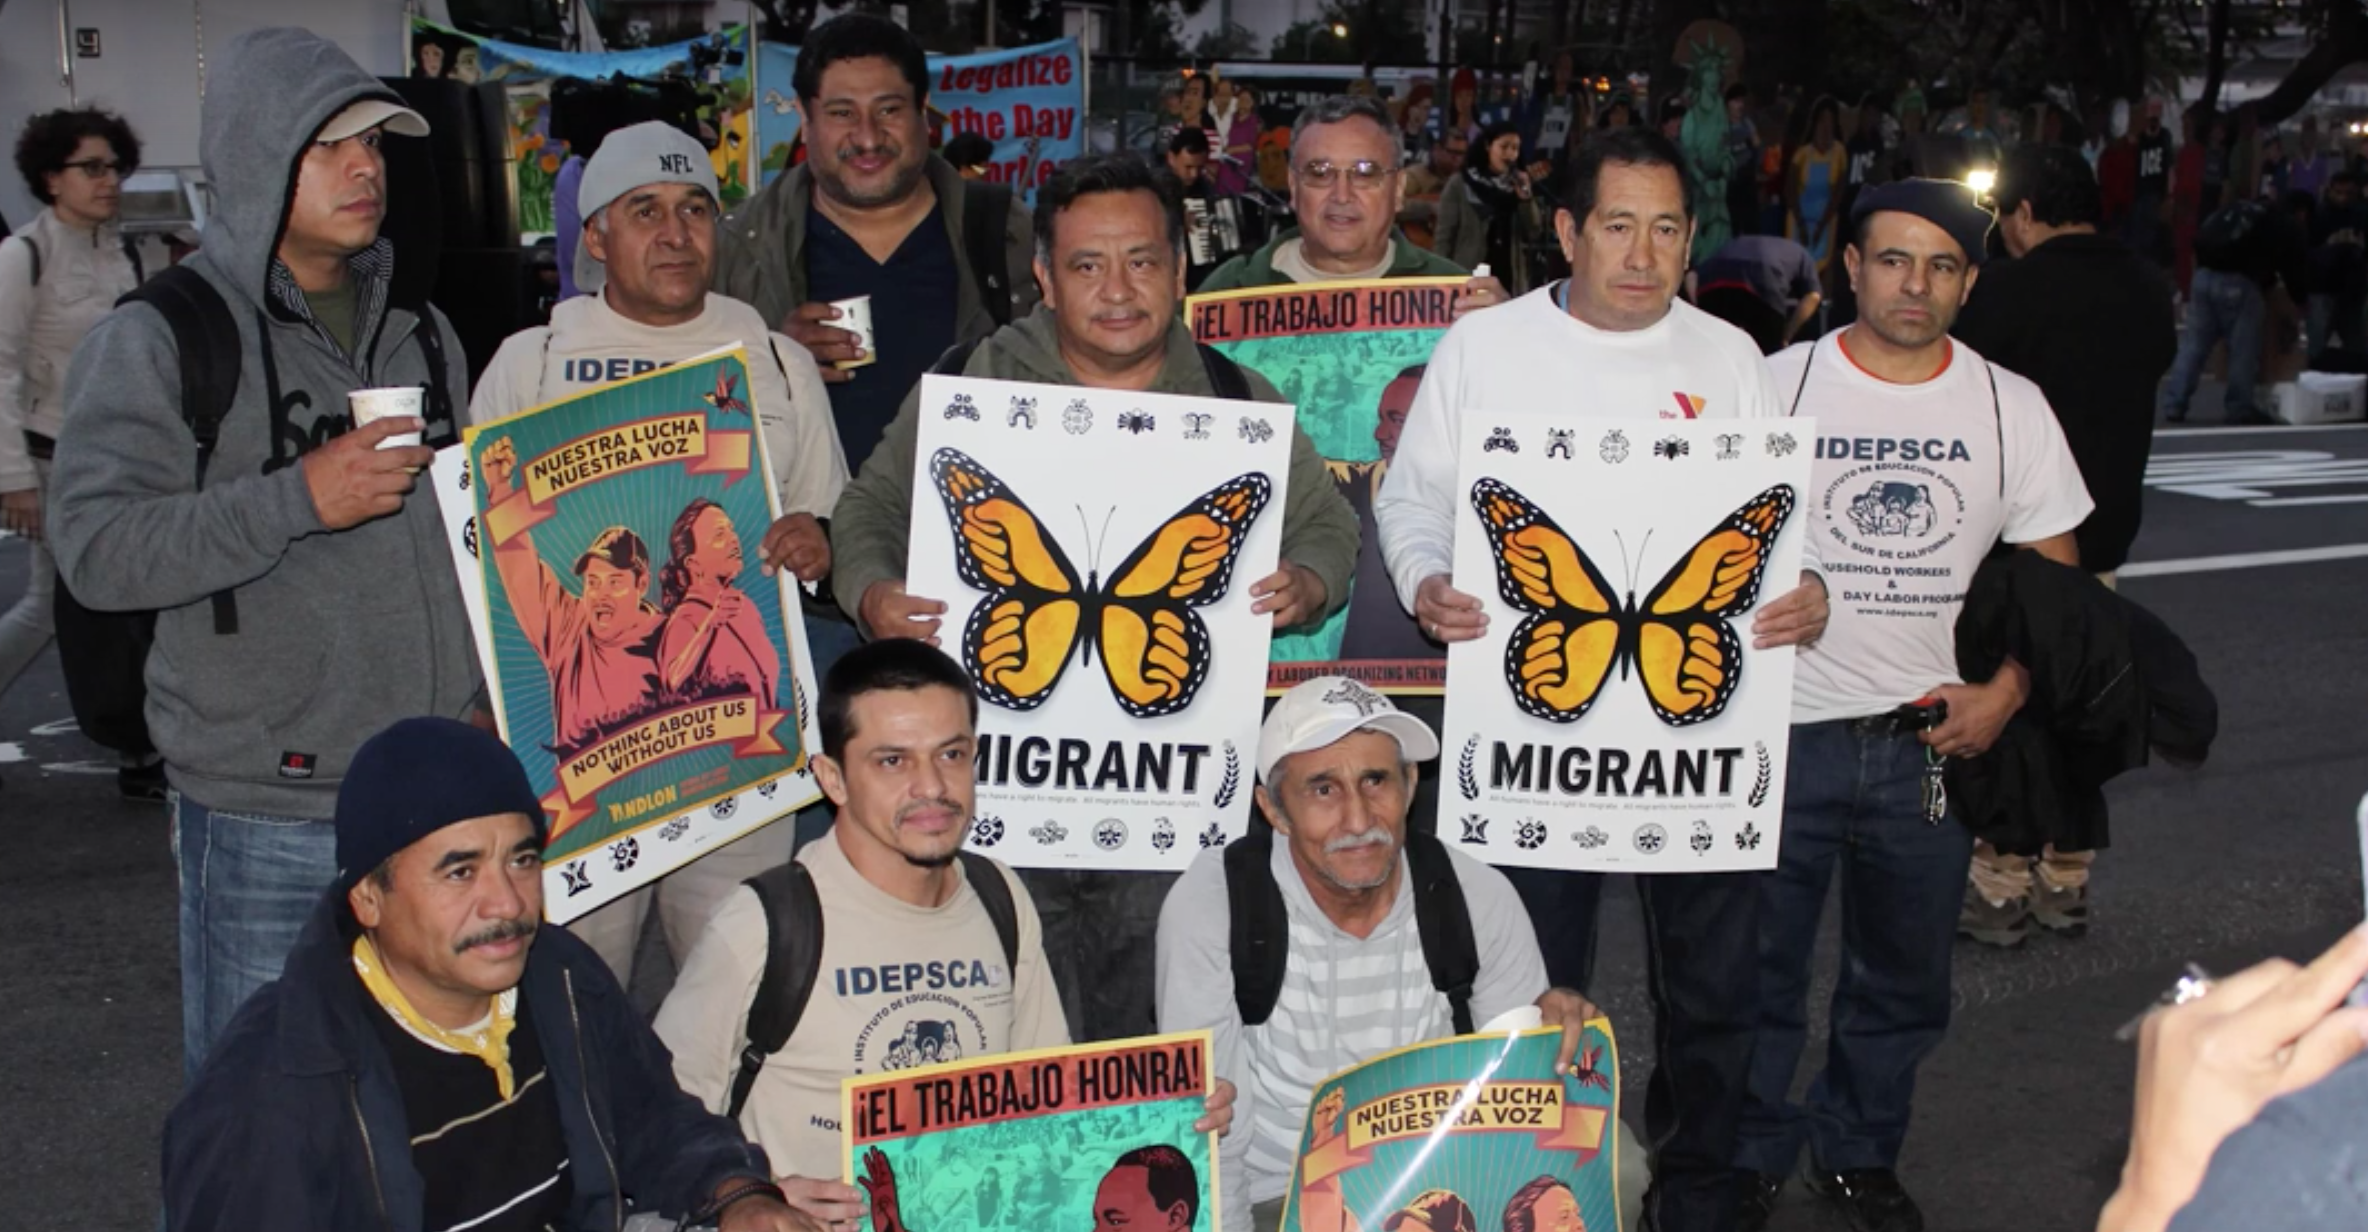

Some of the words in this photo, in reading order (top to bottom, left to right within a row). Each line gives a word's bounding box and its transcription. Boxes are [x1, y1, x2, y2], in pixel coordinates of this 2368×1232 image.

[939, 54, 1072, 94] Legalize
[950, 105, 1005, 141] the
[1012, 103, 1074, 140] Day
[659, 153, 693, 174] NFL
[2140, 147, 2163, 177] ICE
[1196, 304, 1231, 340] ¡EL
[1240, 291, 1357, 338] TRABAJO
[534, 434, 627, 480] NUESTRA
[632, 418, 700, 446] LUCHA
[550, 450, 642, 491] NUESTRA
[647, 437, 690, 459] VOZ
[1816, 437, 1971, 462] IDEPSCA
[1823, 468, 1858, 509] INSTITUTO
[1859, 464, 1873, 473] DE
[1937, 473, 1965, 512] POPULAR
[1830, 526, 1848, 547] DEL
[1850, 542, 1876, 556] SUR
[1878, 549, 1895, 559] DE
[1897, 531, 1956, 560] CALIFORNIA
[1887, 579, 1898, 589] &
[1894, 565, 1952, 577] WORKERS
[1843, 590, 1872, 602] DAY
[1875, 592, 1920, 604] LABOR
[571, 725, 653, 777] NOTHING
[657, 706, 720, 735] ABOUT
[723, 701, 747, 718] US
[606, 735, 687, 776] WITHOUT
[692, 723, 716, 742] US
[1490, 740, 1744, 798] MIGRANT
[835, 959, 989, 997] IDEPSCA
[854, 1007, 890, 1061] INSTITUTO
[890, 998, 905, 1011] DE
[960, 1004, 988, 1050] POPULAR
[858, 1087, 907, 1138] ¡EL
[914, 1062, 1063, 1128] TRABAJO
[1079, 1045, 1201, 1104] HONRA!
[1356, 1088, 1464, 1126] NUESTRA
[1477, 1087, 1559, 1106] LUCHA
[1493, 1107, 1543, 1125] VOZ
